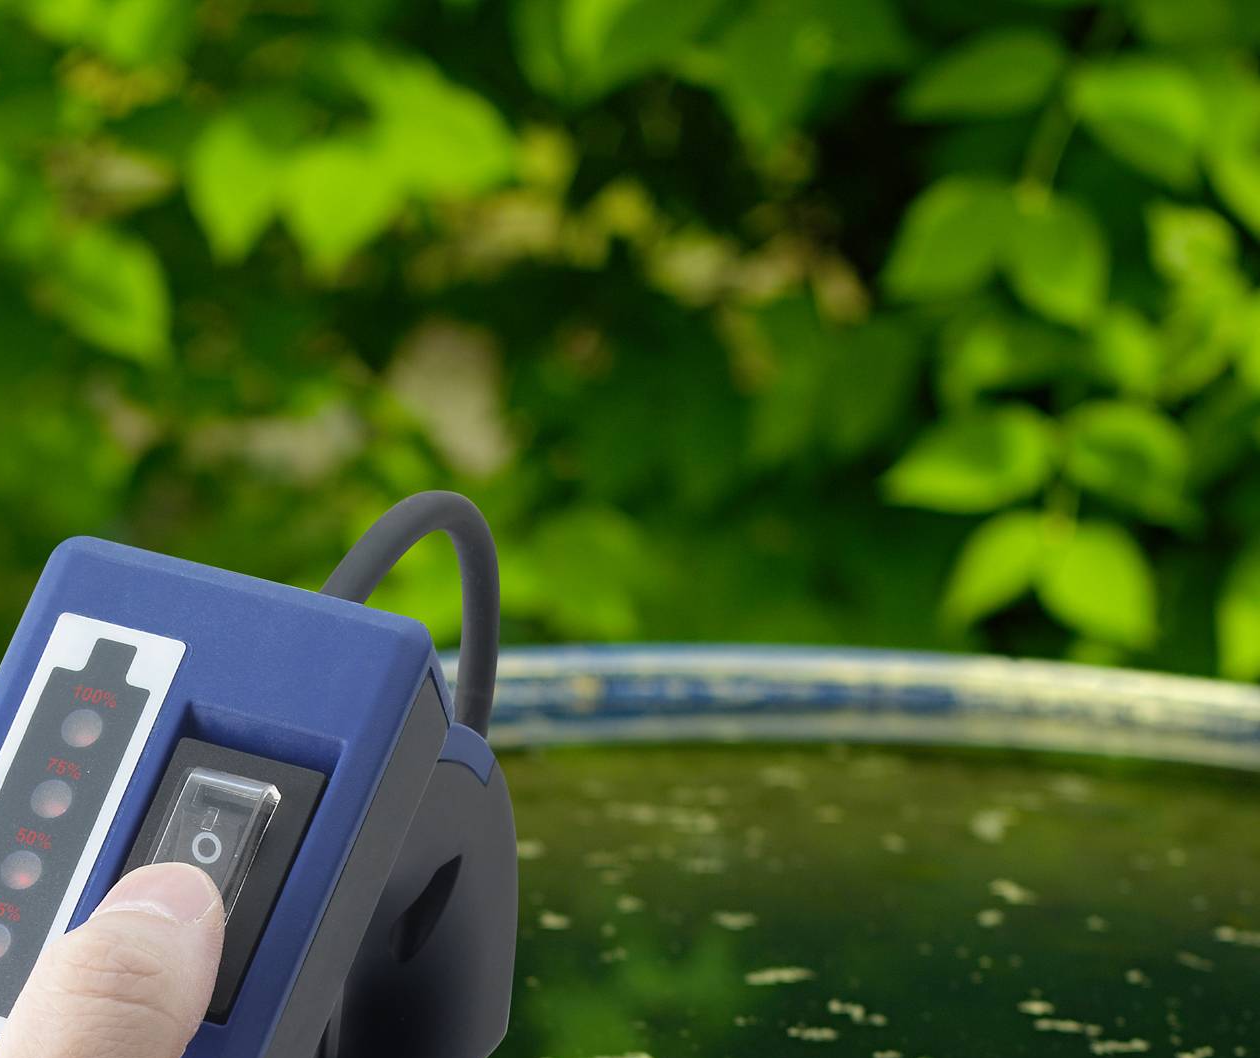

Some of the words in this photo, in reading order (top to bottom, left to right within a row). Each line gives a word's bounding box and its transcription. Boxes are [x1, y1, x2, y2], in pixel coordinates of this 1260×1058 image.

[73, 684, 117, 709] 100%
[46, 756, 82, 781] 75%
[16, 827, 52, 850] 50%
